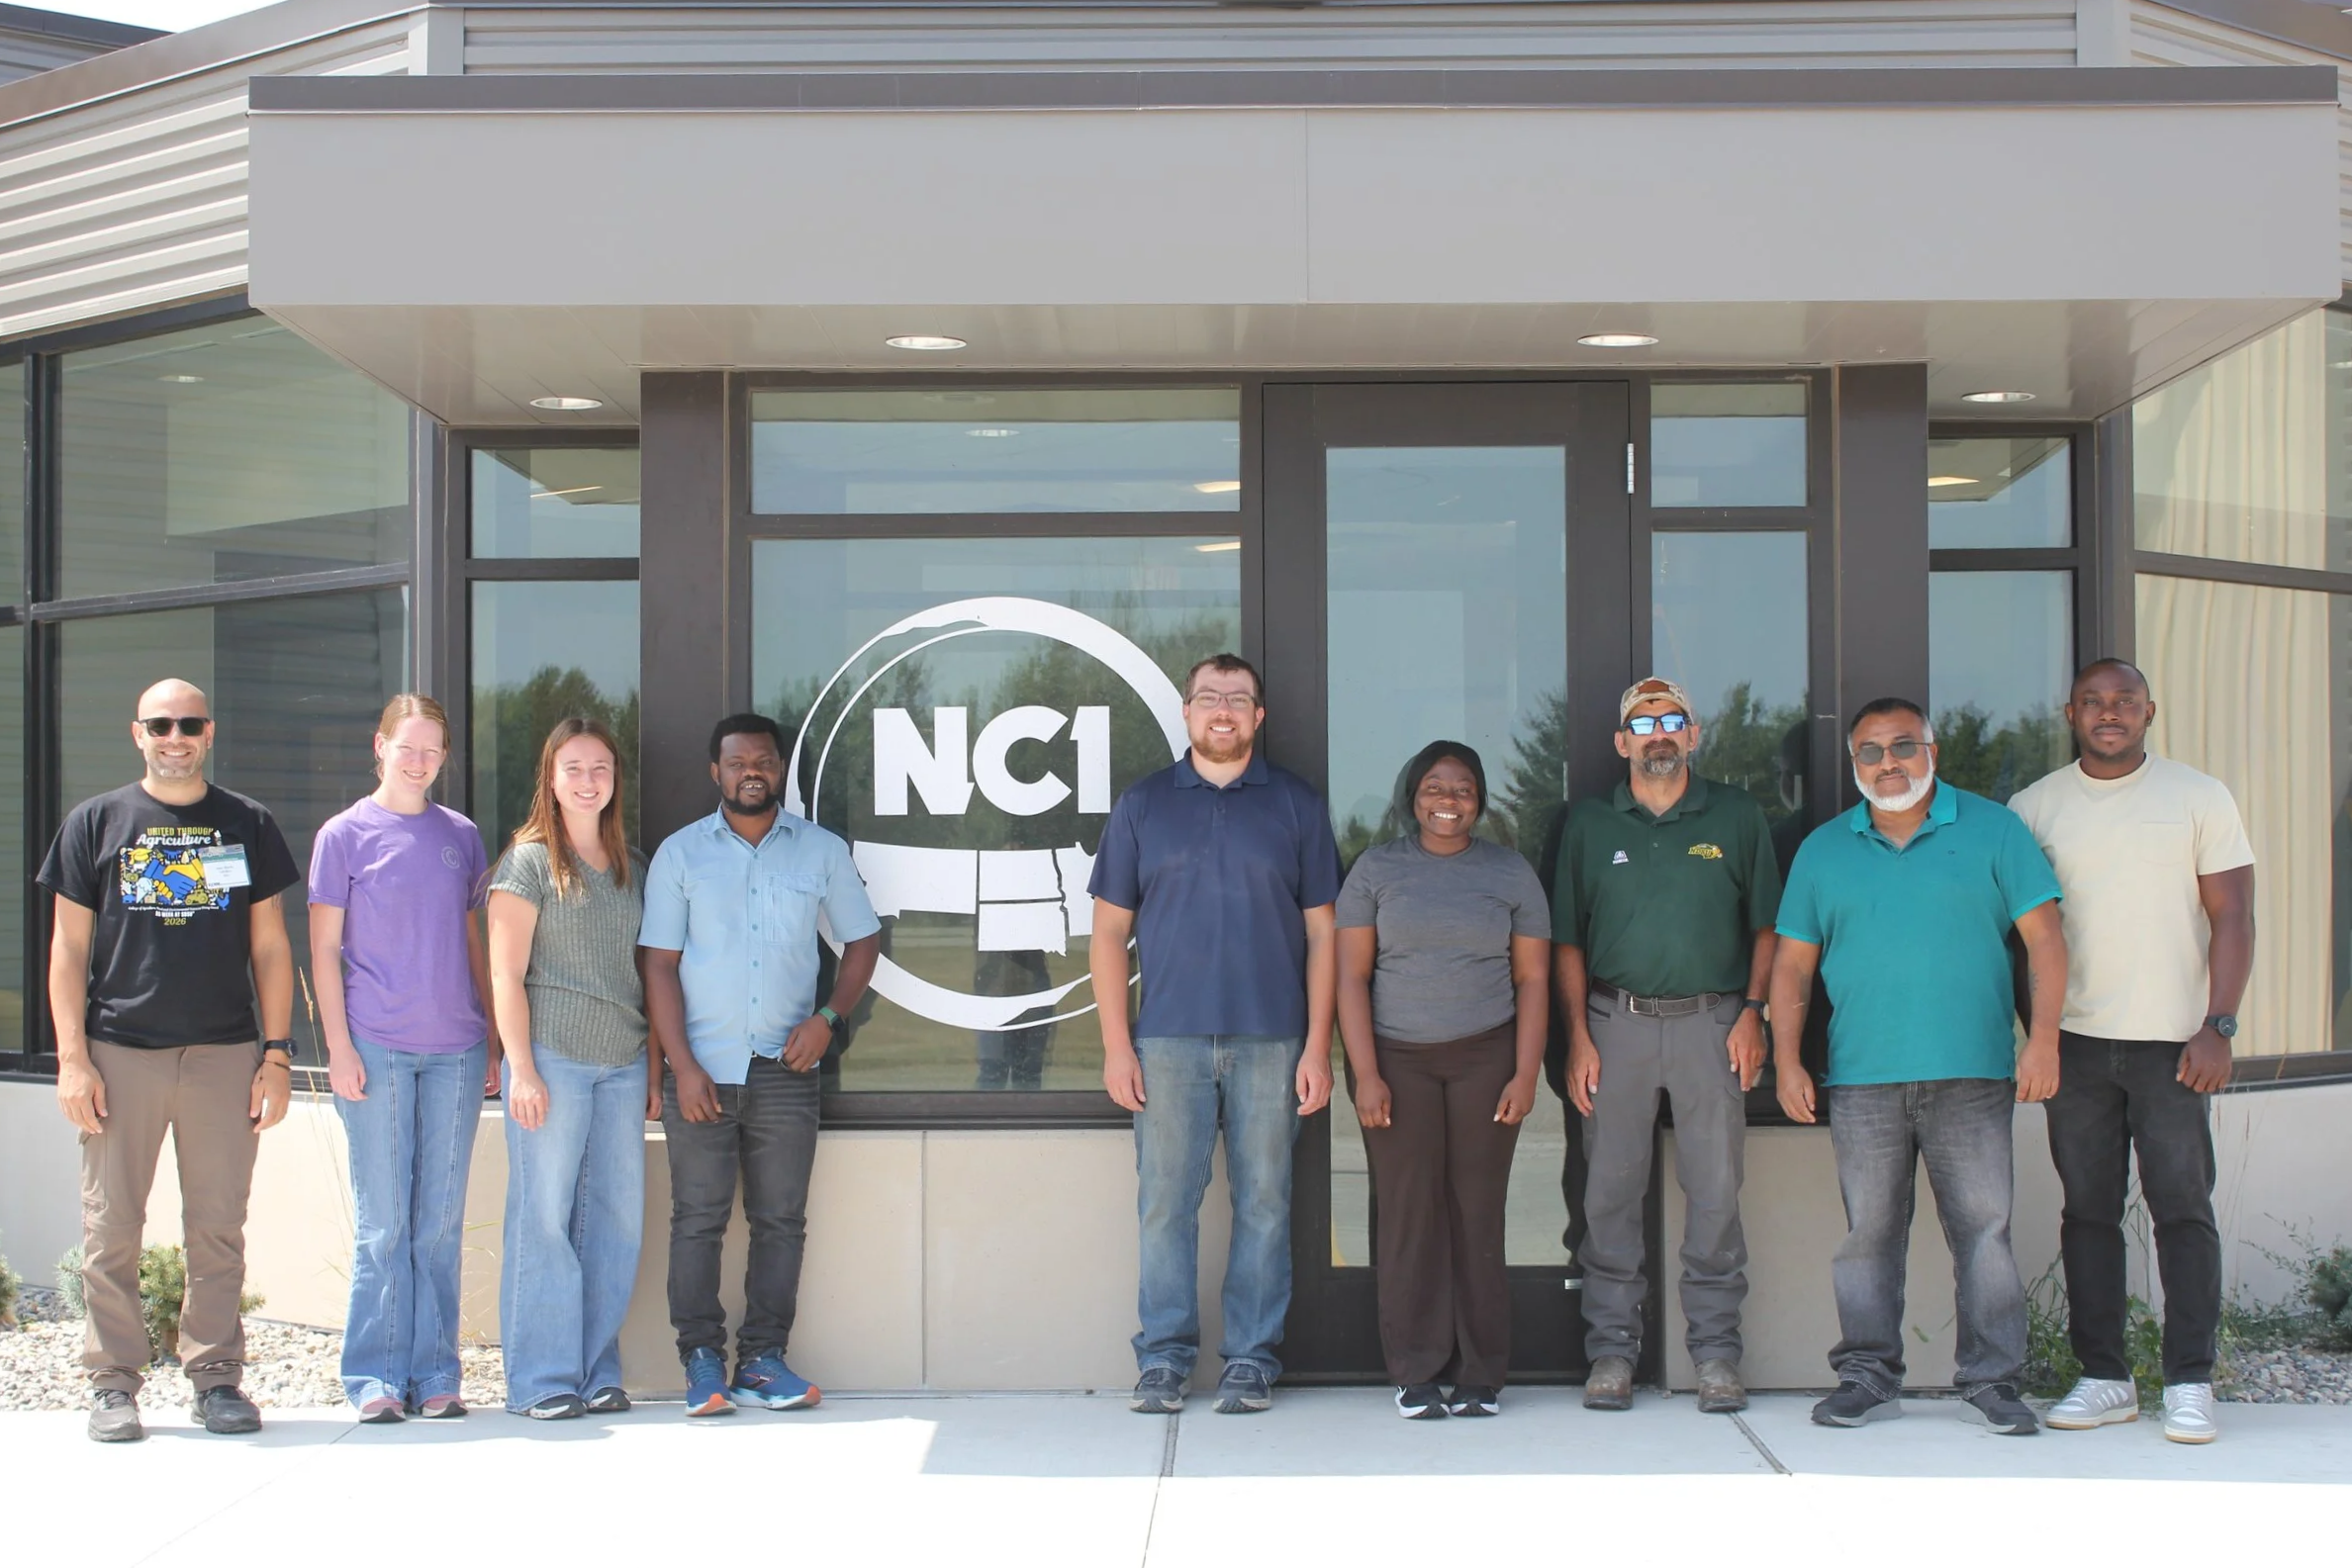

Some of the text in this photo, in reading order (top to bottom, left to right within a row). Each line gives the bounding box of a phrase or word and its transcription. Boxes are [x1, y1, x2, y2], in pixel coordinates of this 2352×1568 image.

[873, 704, 1111, 816] NC1
[147, 827, 175, 836] UNITED
[137, 833, 212, 849] Agriculture
